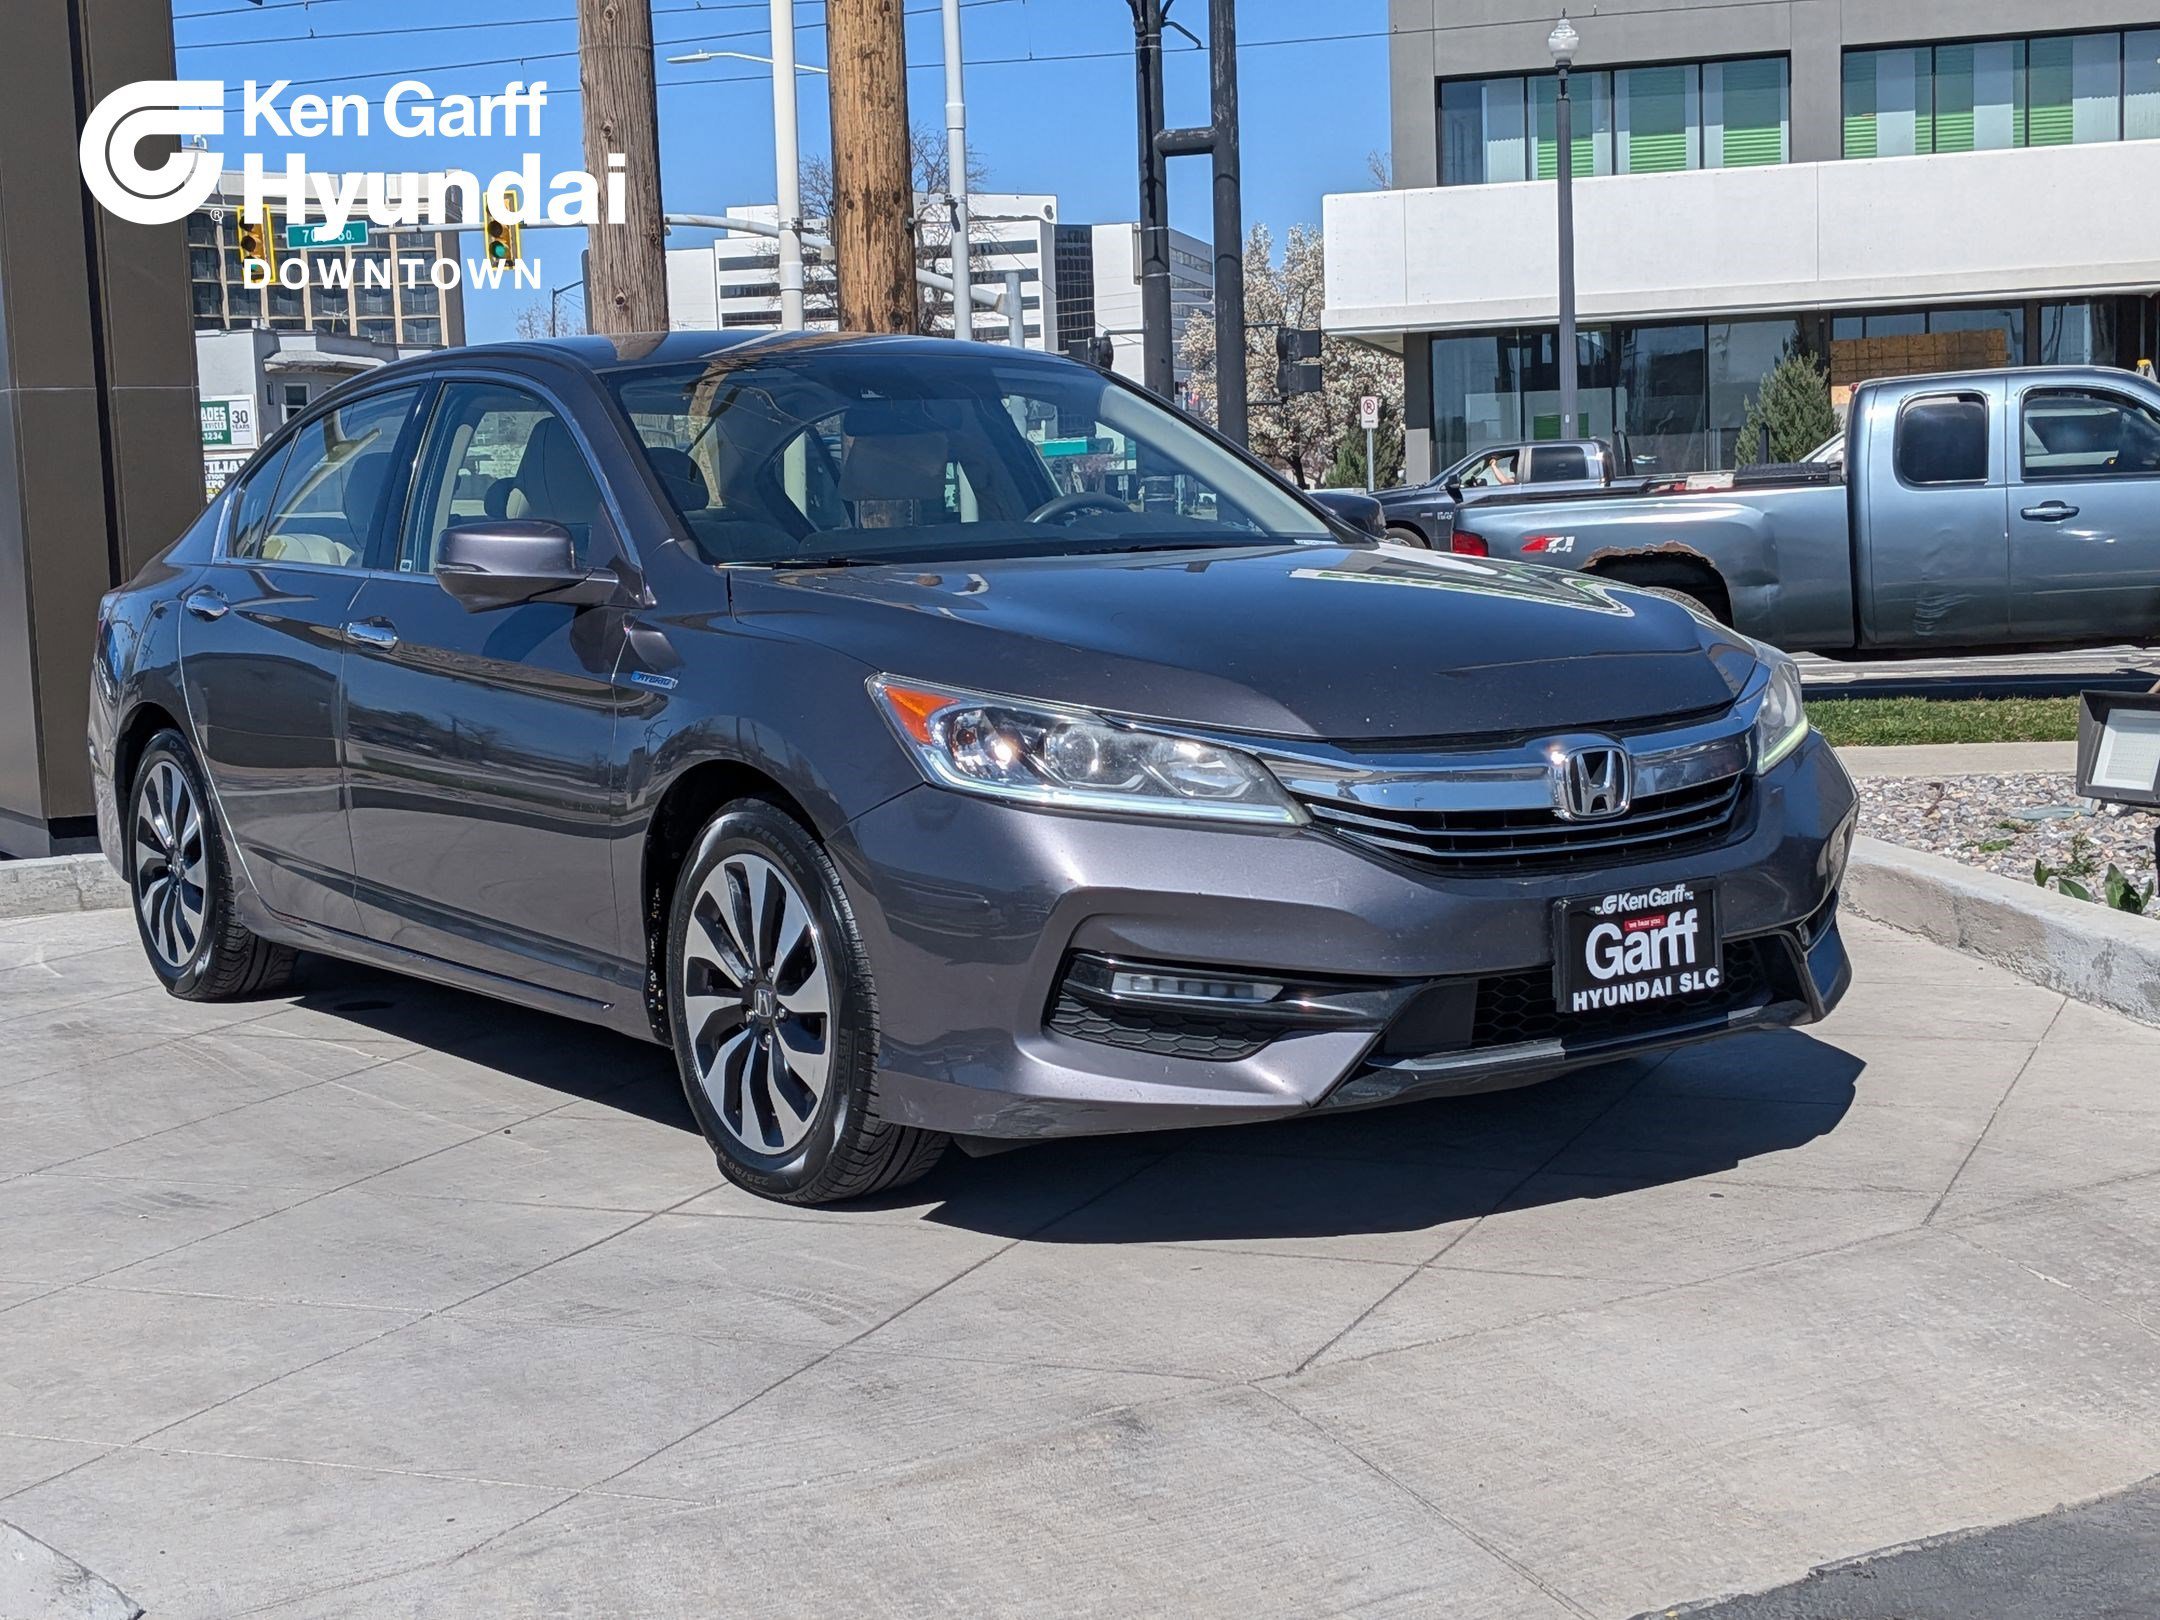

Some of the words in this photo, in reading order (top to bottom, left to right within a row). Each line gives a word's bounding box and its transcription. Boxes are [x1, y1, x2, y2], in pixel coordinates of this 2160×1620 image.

[231, 410, 249, 424] 30
[1617, 892, 1649, 913] Ken
[1648, 883, 1686, 907] Garff
[1585, 908, 1698, 980] Garff
[1572, 975, 1672, 1013] HYUNDAI
[1678, 967, 1720, 994] SLC
